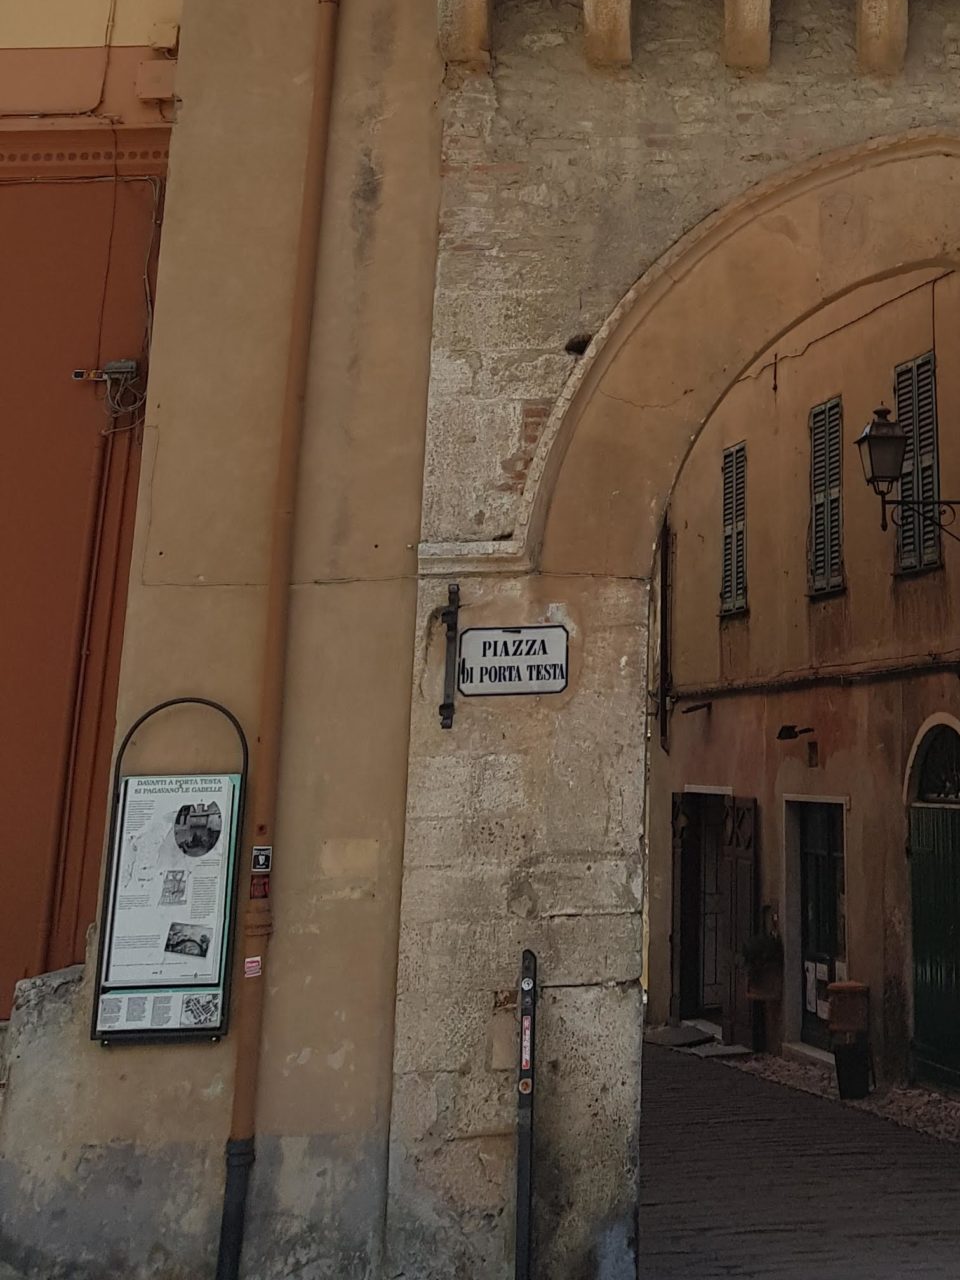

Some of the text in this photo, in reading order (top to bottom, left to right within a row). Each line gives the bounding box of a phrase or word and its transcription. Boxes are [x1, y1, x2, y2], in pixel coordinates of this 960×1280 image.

[482, 639, 549, 658] PIAZZA
[479, 663, 523, 683] PORTA
[527, 663, 566, 681] TESTA
